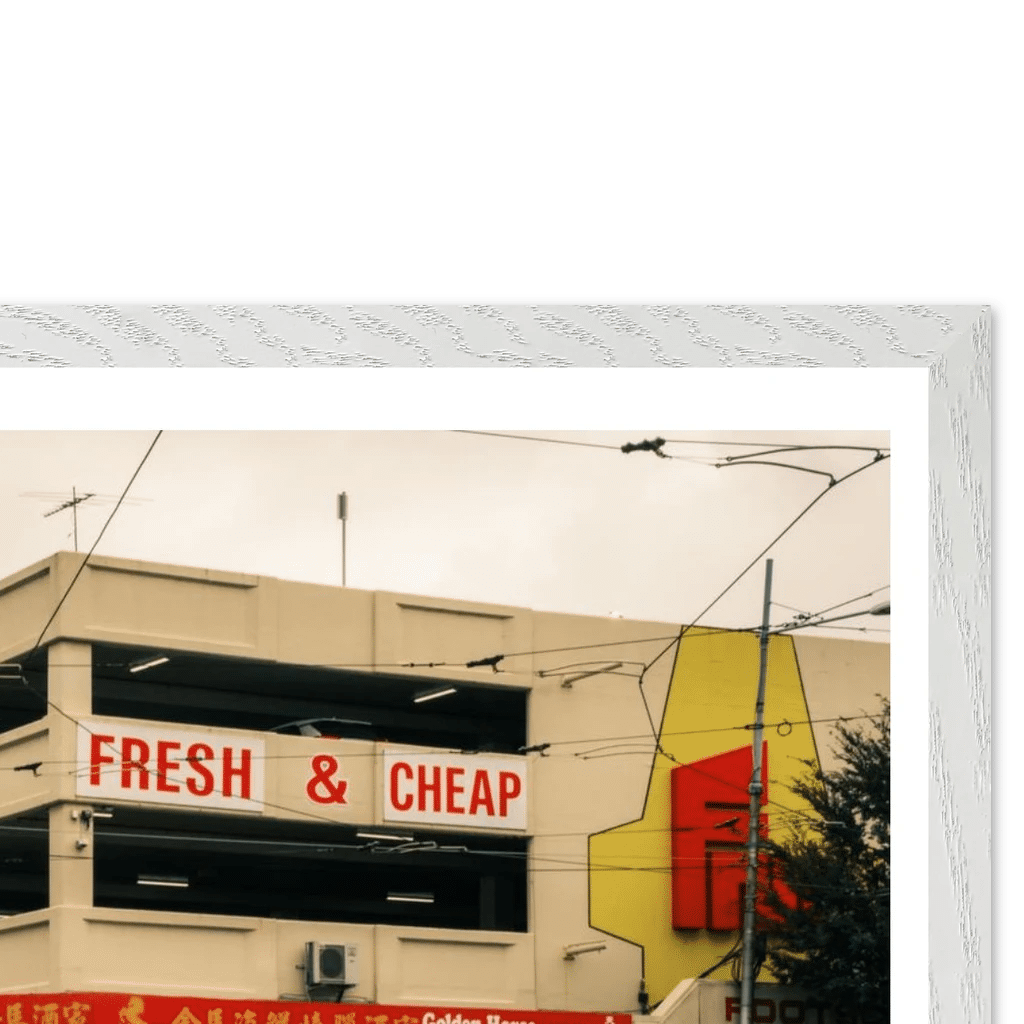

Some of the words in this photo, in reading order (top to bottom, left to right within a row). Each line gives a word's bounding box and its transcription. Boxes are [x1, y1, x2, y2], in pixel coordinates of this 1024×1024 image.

[89, 733, 252, 800] FRESH
[306, 754, 348, 805] &
[389, 761, 522, 818] CHEAP
